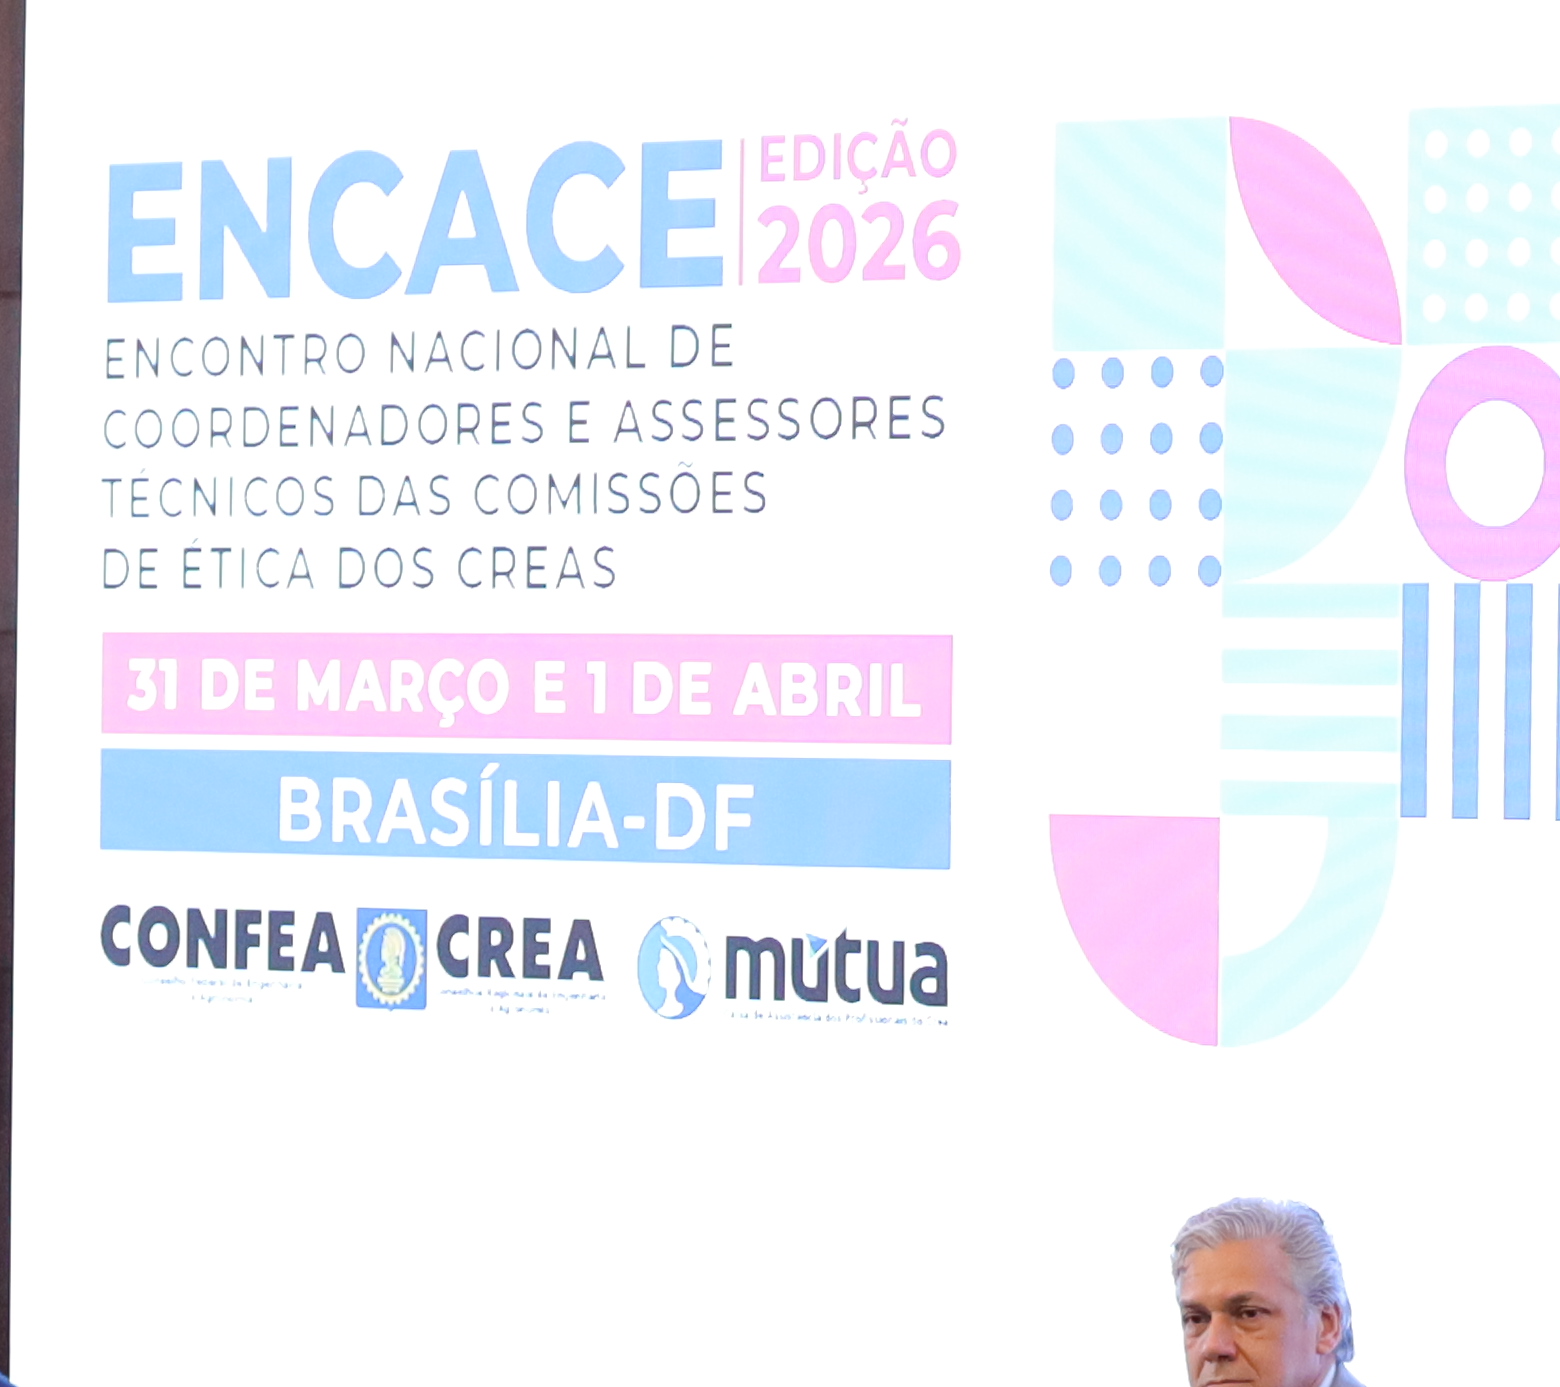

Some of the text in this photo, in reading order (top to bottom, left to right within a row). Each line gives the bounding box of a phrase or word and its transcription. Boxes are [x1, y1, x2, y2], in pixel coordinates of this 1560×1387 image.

[761, 119, 957, 194] EDIÇÃO
[108, 140, 723, 303] ENCACE
[758, 200, 961, 283] 2026
[106, 323, 733, 379] ENCONTRO NACIONAL DE
[104, 395, 945, 449] COORDENADORES E ASSESSORES
[100, 462, 765, 518] TÉCNICOS DAS COMISSÕES
[103, 538, 615, 589] DE ÉTICA DOS CREAS
[127, 658, 921, 728] 31 DE MARÇO E 1 DE ABRIL
[279, 764, 754, 851] BRASÍLIA-DF
[100, 904, 346, 974] CONFEA
[436, 914, 604, 982] CREA
[725, 928, 948, 1007] mútua
